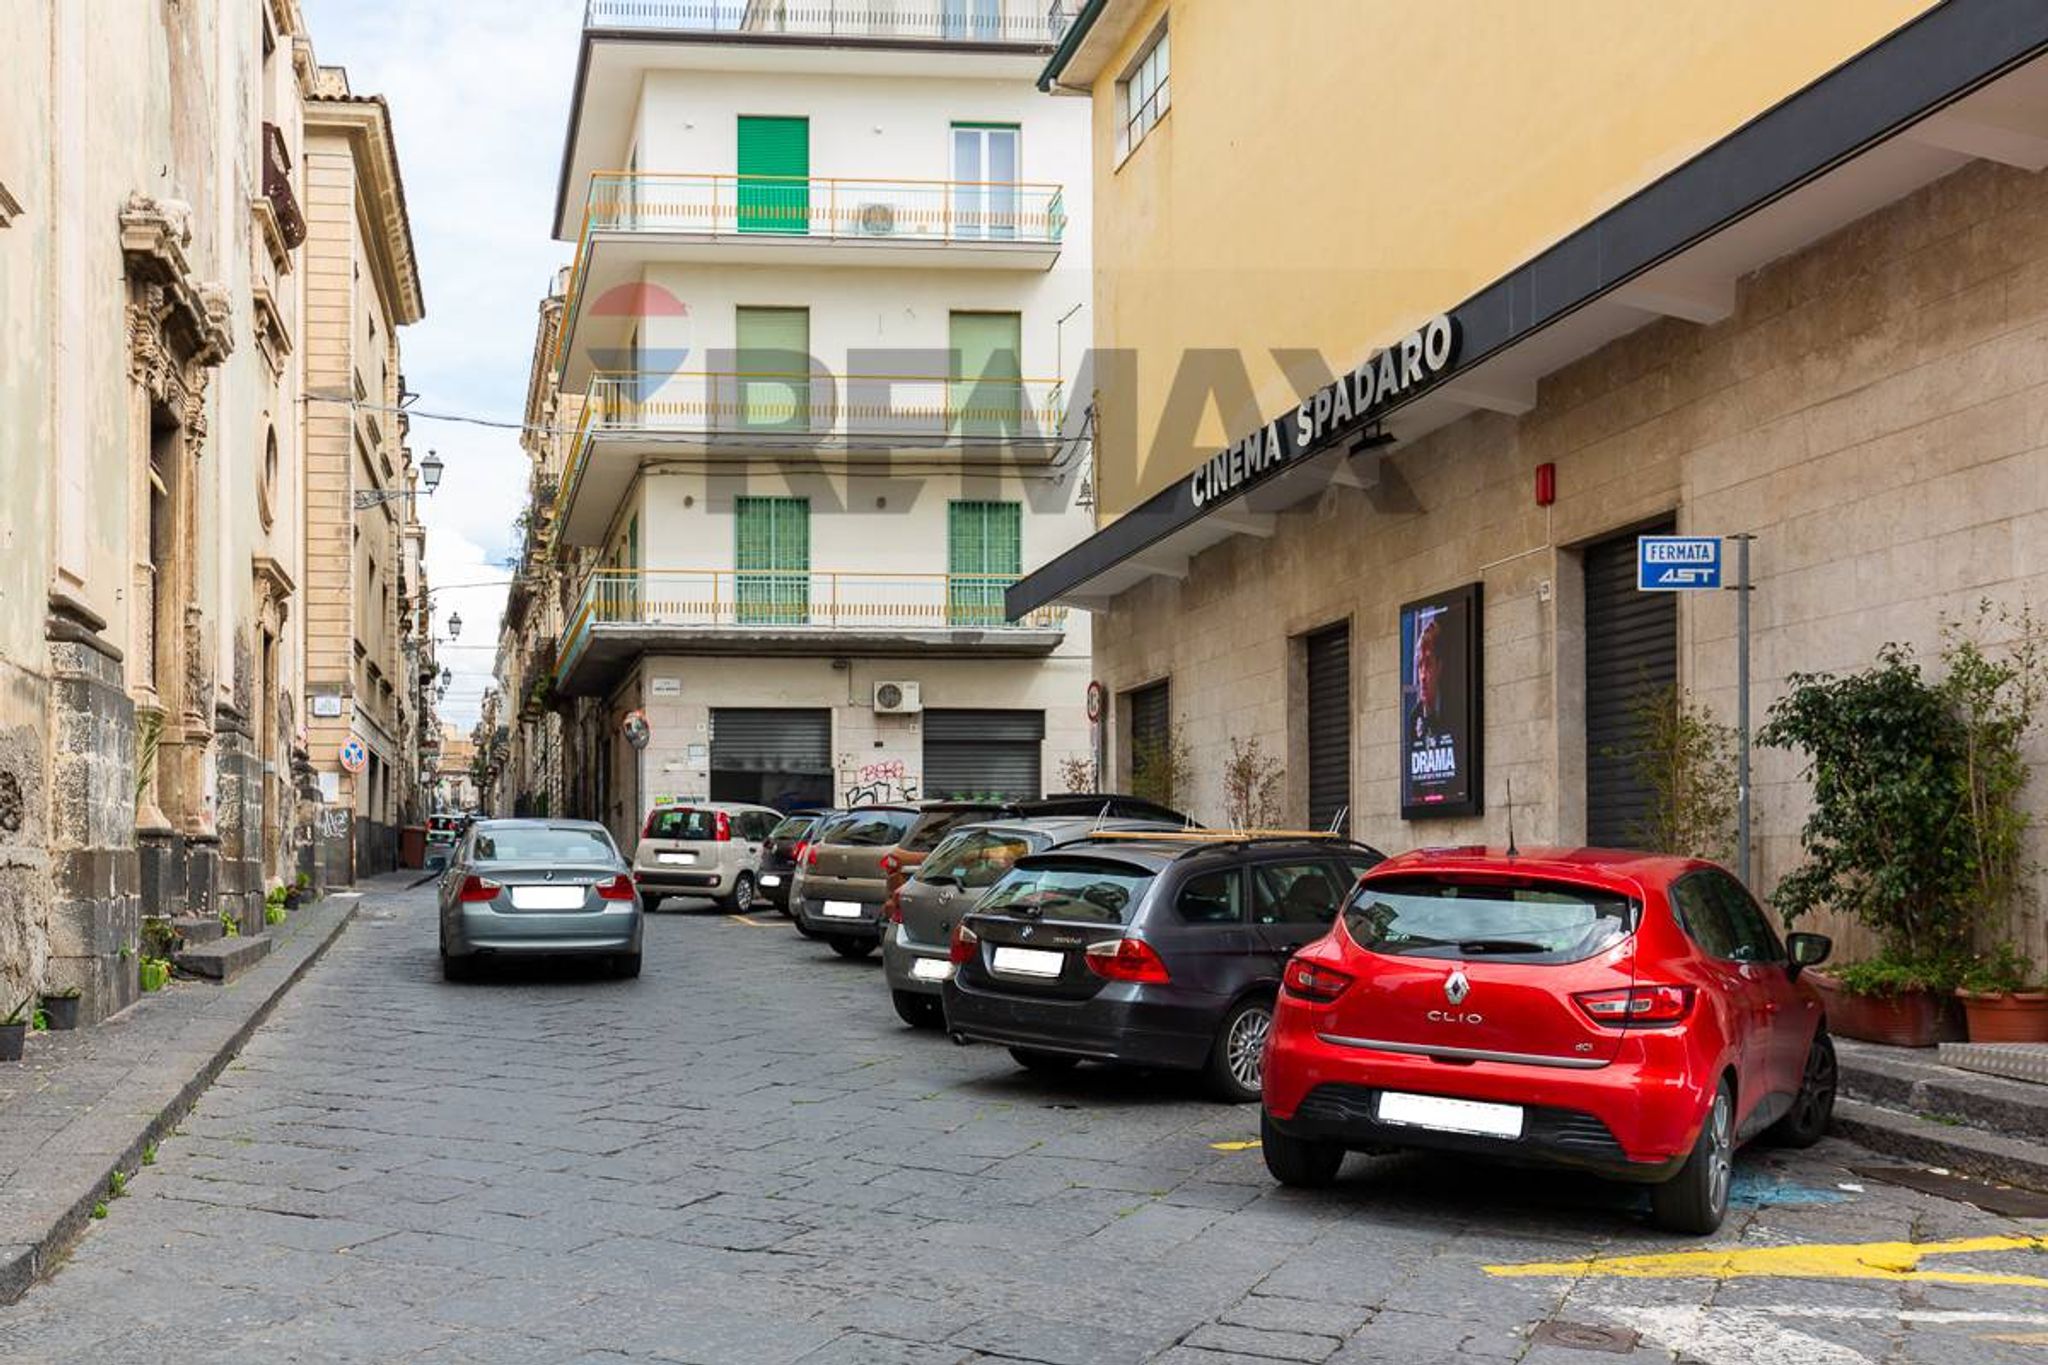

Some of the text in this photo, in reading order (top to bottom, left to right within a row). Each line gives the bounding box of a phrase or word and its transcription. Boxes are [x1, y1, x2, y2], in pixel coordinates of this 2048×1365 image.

[1191, 314, 1451, 507] CINEMA SPADARO
[1651, 544, 1710, 560] FERMATA
[1659, 568, 1715, 583] AST
[1411, 747, 1455, 775] DRAMA
[1427, 1010, 1482, 1024] CLIO
